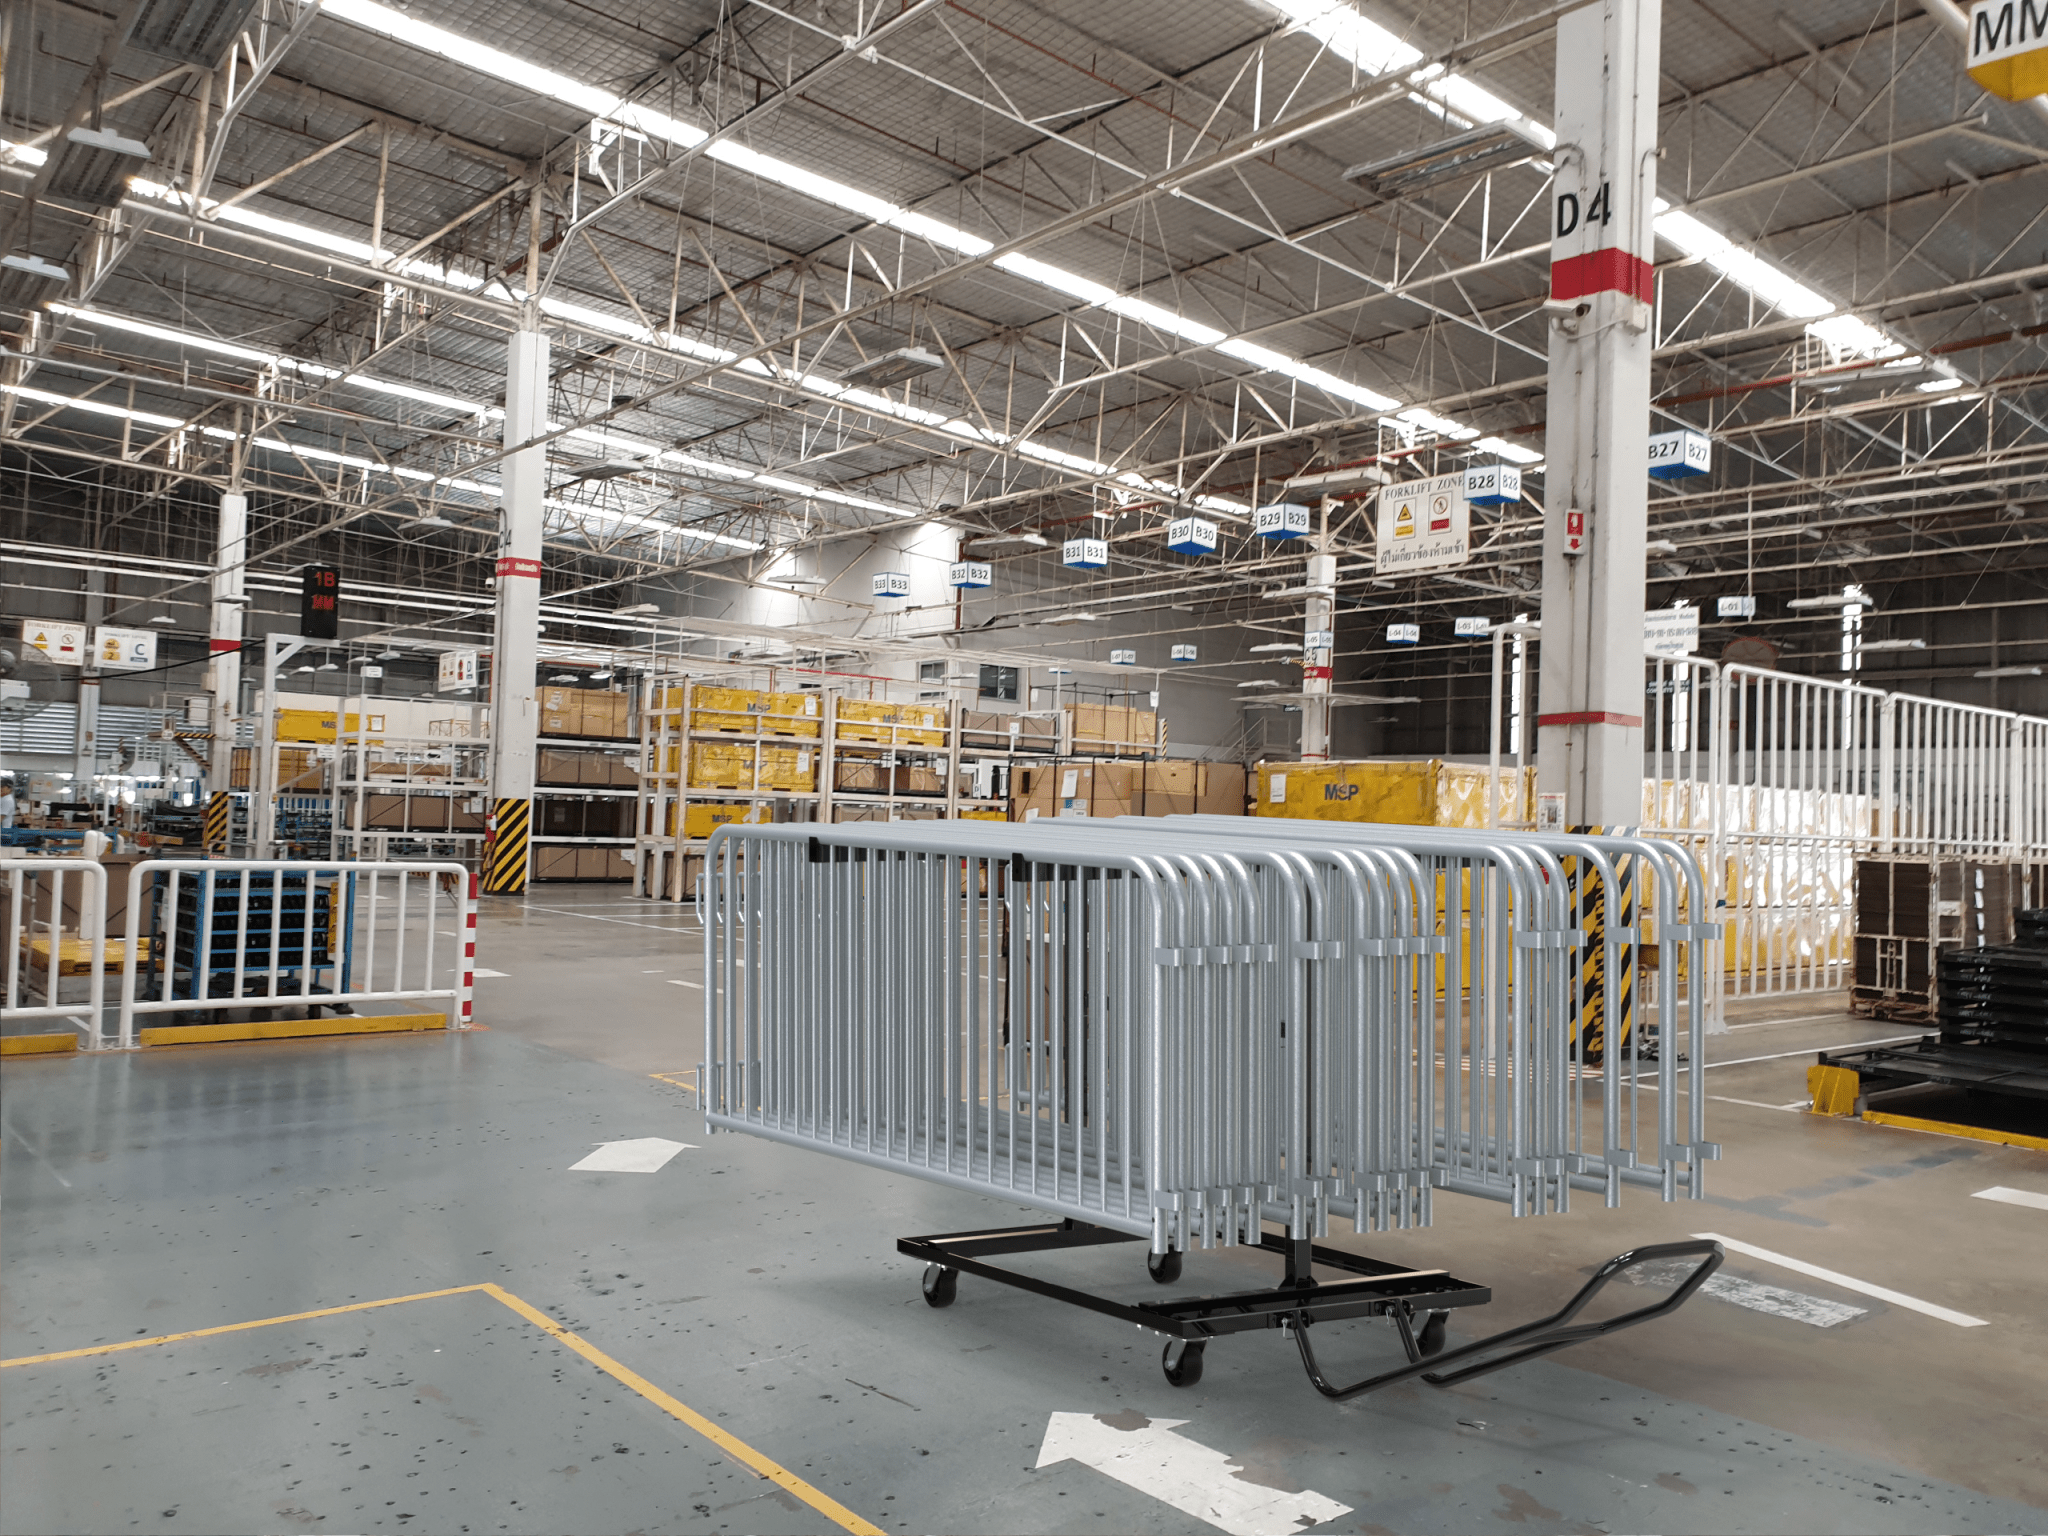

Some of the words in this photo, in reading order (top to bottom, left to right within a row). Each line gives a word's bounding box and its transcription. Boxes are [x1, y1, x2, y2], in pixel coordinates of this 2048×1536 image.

[1648, 441, 1679, 460] B27
[1689, 443, 1708, 462] B27
[1385, 481, 1433, 500] FORKLIFT
[1437, 476, 1465, 491] ZONE
[1468, 474, 1496, 491] B28
[1502, 474, 1518, 491] B28
[1260, 510, 1280, 526] B29
[1288, 511, 1307, 527] B29
[1172, 525, 1189, 538] B30
[1196, 526, 1214, 541] B30
[1066, 547, 1081, 558] B31
[1087, 546, 1103, 558] B31
[951, 569, 966, 580] B32
[971, 568, 988, 580] B32
[874, 579, 886, 589] B33
[891, 579, 908, 590] B33
[135, 643, 145, 656] C
[321, 720, 337, 729] MS
[742, 759, 768, 770] MP
[1325, 783, 1359, 801] MSP
[711, 814, 733, 823] MSP
